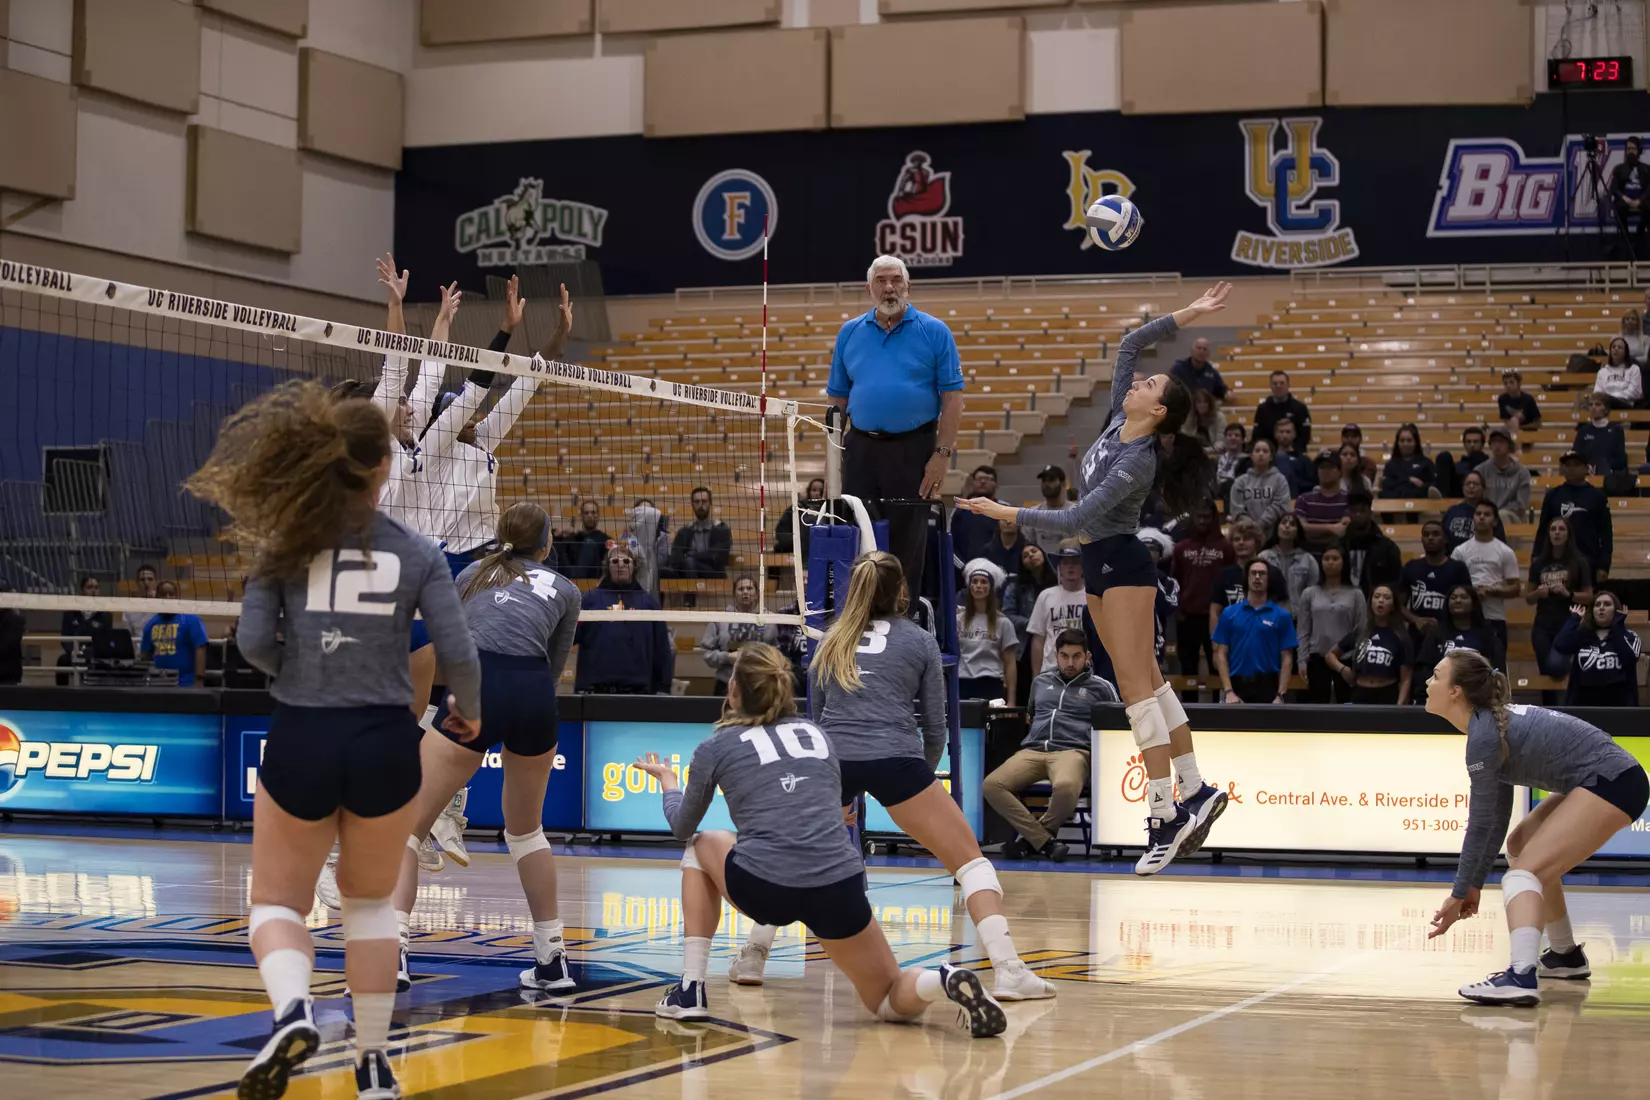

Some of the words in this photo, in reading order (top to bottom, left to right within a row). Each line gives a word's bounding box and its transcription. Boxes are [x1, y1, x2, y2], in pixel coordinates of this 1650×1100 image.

[1576, 61, 1619, 81] 7:23
[1239, 117, 1340, 236] UC
[457, 202, 506, 251] CAL
[540, 201, 607, 245] POLY
[720, 190, 752, 241] F
[877, 217, 964, 257] CSUN
[1234, 230, 1355, 266] RIVERSIDE
[0, 261, 73, 293] OLLEYBALL
[902, 256, 953, 268] ATADORS
[148, 288, 163, 308] UC
[168, 292, 229, 321] RIVERSIDE
[233, 307, 297, 332] VOLLEYBALL
[357, 327, 371, 345] UC
[374, 331, 425, 355] RIVERSIDE
[427, 341, 480, 364] VOLLEYBALL
[530, 358, 543, 373] UC
[545, 359, 586, 381] RIVERSIDE
[588, 369, 632, 389] VOLLEYBALL
[672, 383, 682, 396] UC
[684, 385, 718, 404] RIVERSIDE
[305, 548, 401, 616] 12
[151, 623, 179, 641] BEAT
[1367, 650, 1395, 666] CBU
[14, 741, 160, 781] PEPSI
[740, 722, 830, 765] 10
[1256, 790, 1315, 805] Central
[1320, 791, 1353, 805] Ave.
[1359, 792, 1369, 806] &
[1375, 791, 1449, 807] Riverside
